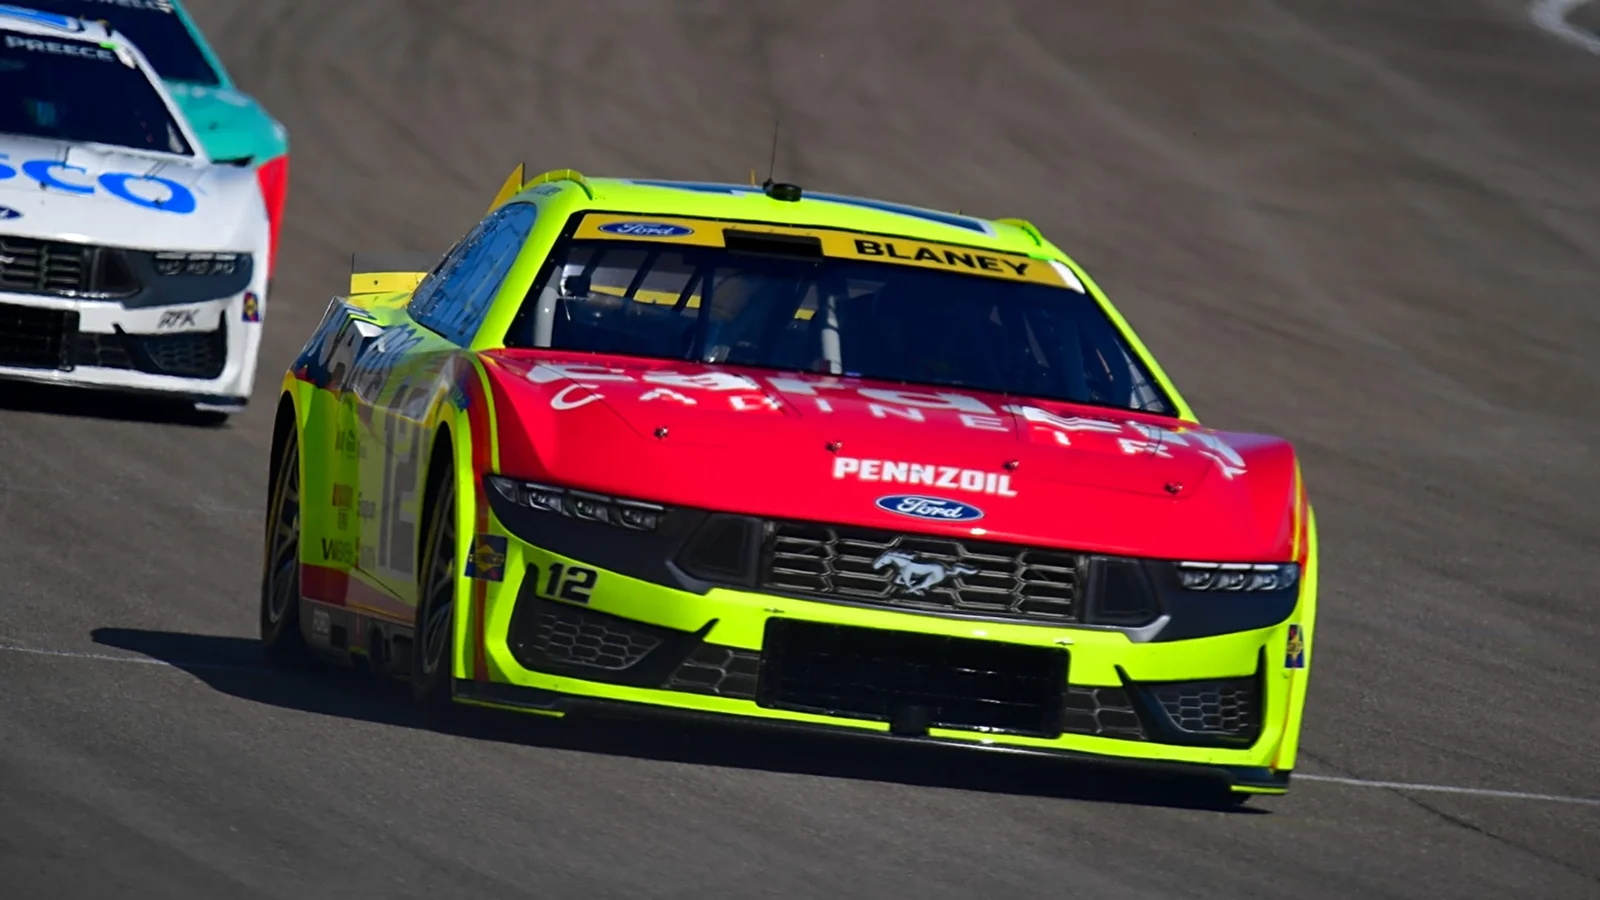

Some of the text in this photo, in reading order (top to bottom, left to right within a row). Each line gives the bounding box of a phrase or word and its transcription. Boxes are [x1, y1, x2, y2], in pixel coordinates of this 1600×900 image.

[5, 35, 114, 62] PREECE
[0, 153, 196, 214] CO
[616, 223, 675, 235] Ford
[854, 239, 1029, 276] BLANEY
[833, 457, 1018, 497] PENNZOIL
[896, 497, 964, 518] Ford
[545, 562, 599, 605] 12
